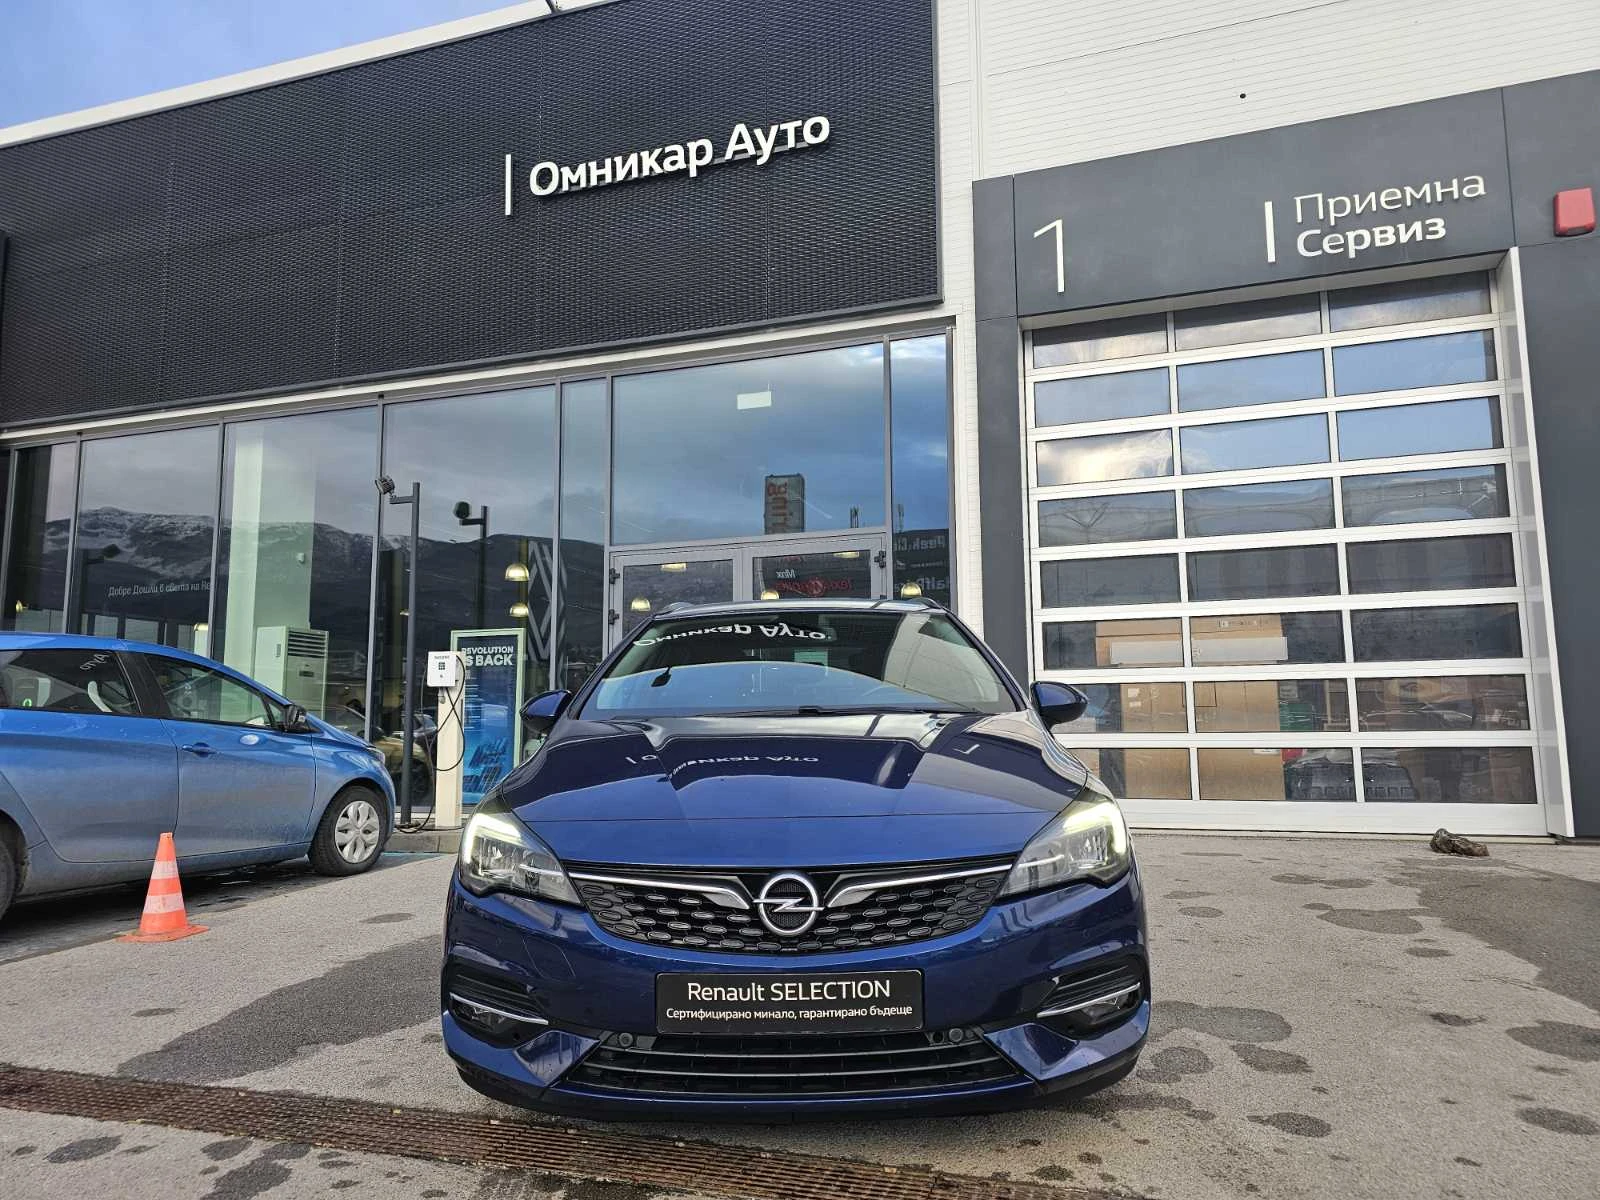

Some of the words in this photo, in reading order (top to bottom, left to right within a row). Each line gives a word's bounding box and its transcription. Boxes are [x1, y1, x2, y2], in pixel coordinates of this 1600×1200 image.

[529, 138, 713, 197] Омникар
[724, 115, 830, 165] Ауто
[1293, 174, 1487, 226] Приемна
[1033, 218, 1065, 293] 1
[1296, 217, 1447, 259] Сервиз
[475, 653, 513, 666] BACK
[687, 982, 765, 1002] Renault
[770, 979, 891, 1001] SELECTION
[666, 1008, 752, 1021] Сертифицирано
[753, 1008, 797, 1020] минало,
[799, 1007, 868, 1020] гарантирано
[869, 1004, 913, 1018] бъдеще
